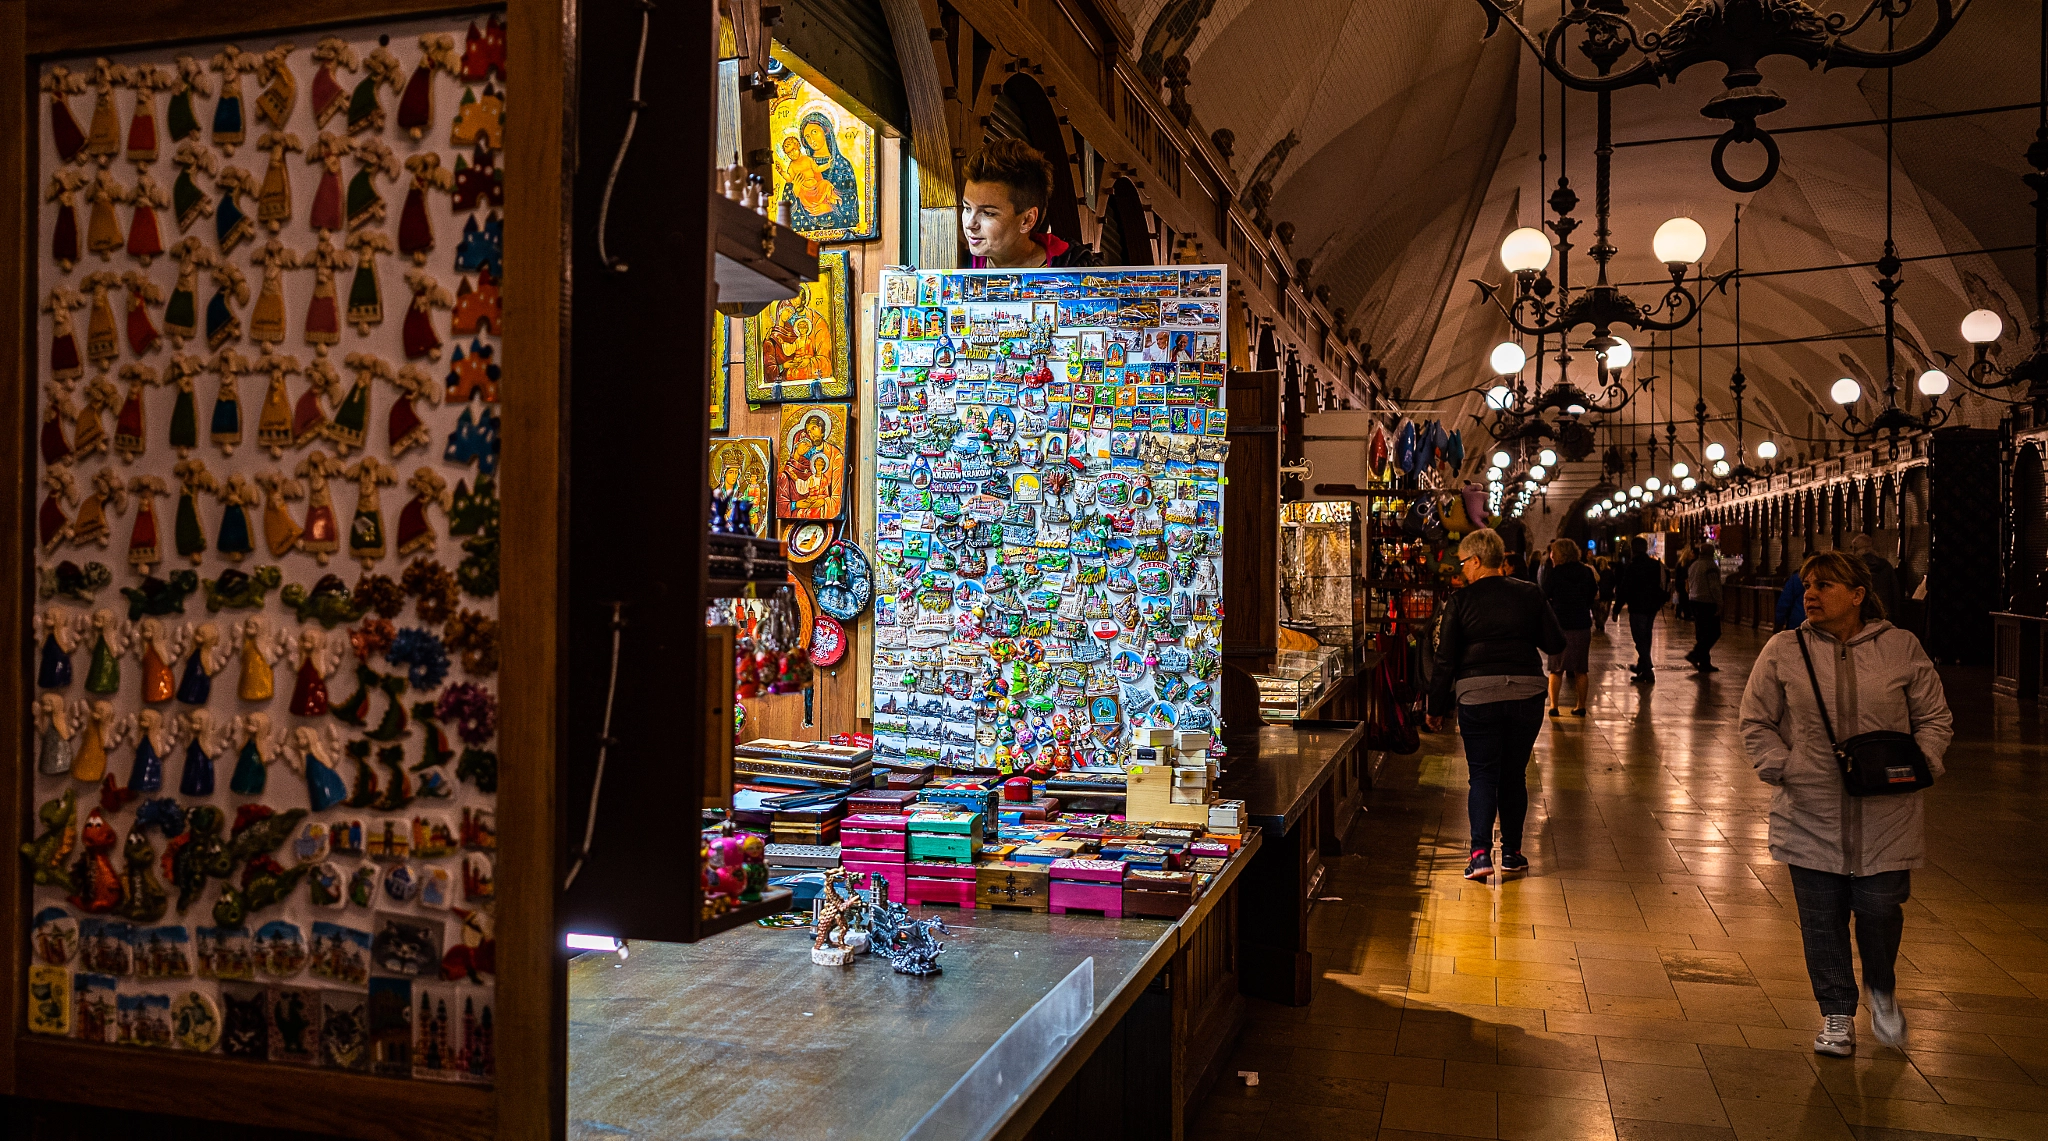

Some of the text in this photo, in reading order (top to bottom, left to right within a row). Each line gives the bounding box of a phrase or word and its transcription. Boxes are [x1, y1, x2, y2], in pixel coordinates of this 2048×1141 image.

[969, 334, 999, 343] KRAKÓW
[932, 470, 961, 479] KRAKÓW
[818, 619, 839, 634] POLSKA
[1185, 625, 1221, 650] KRAKW
